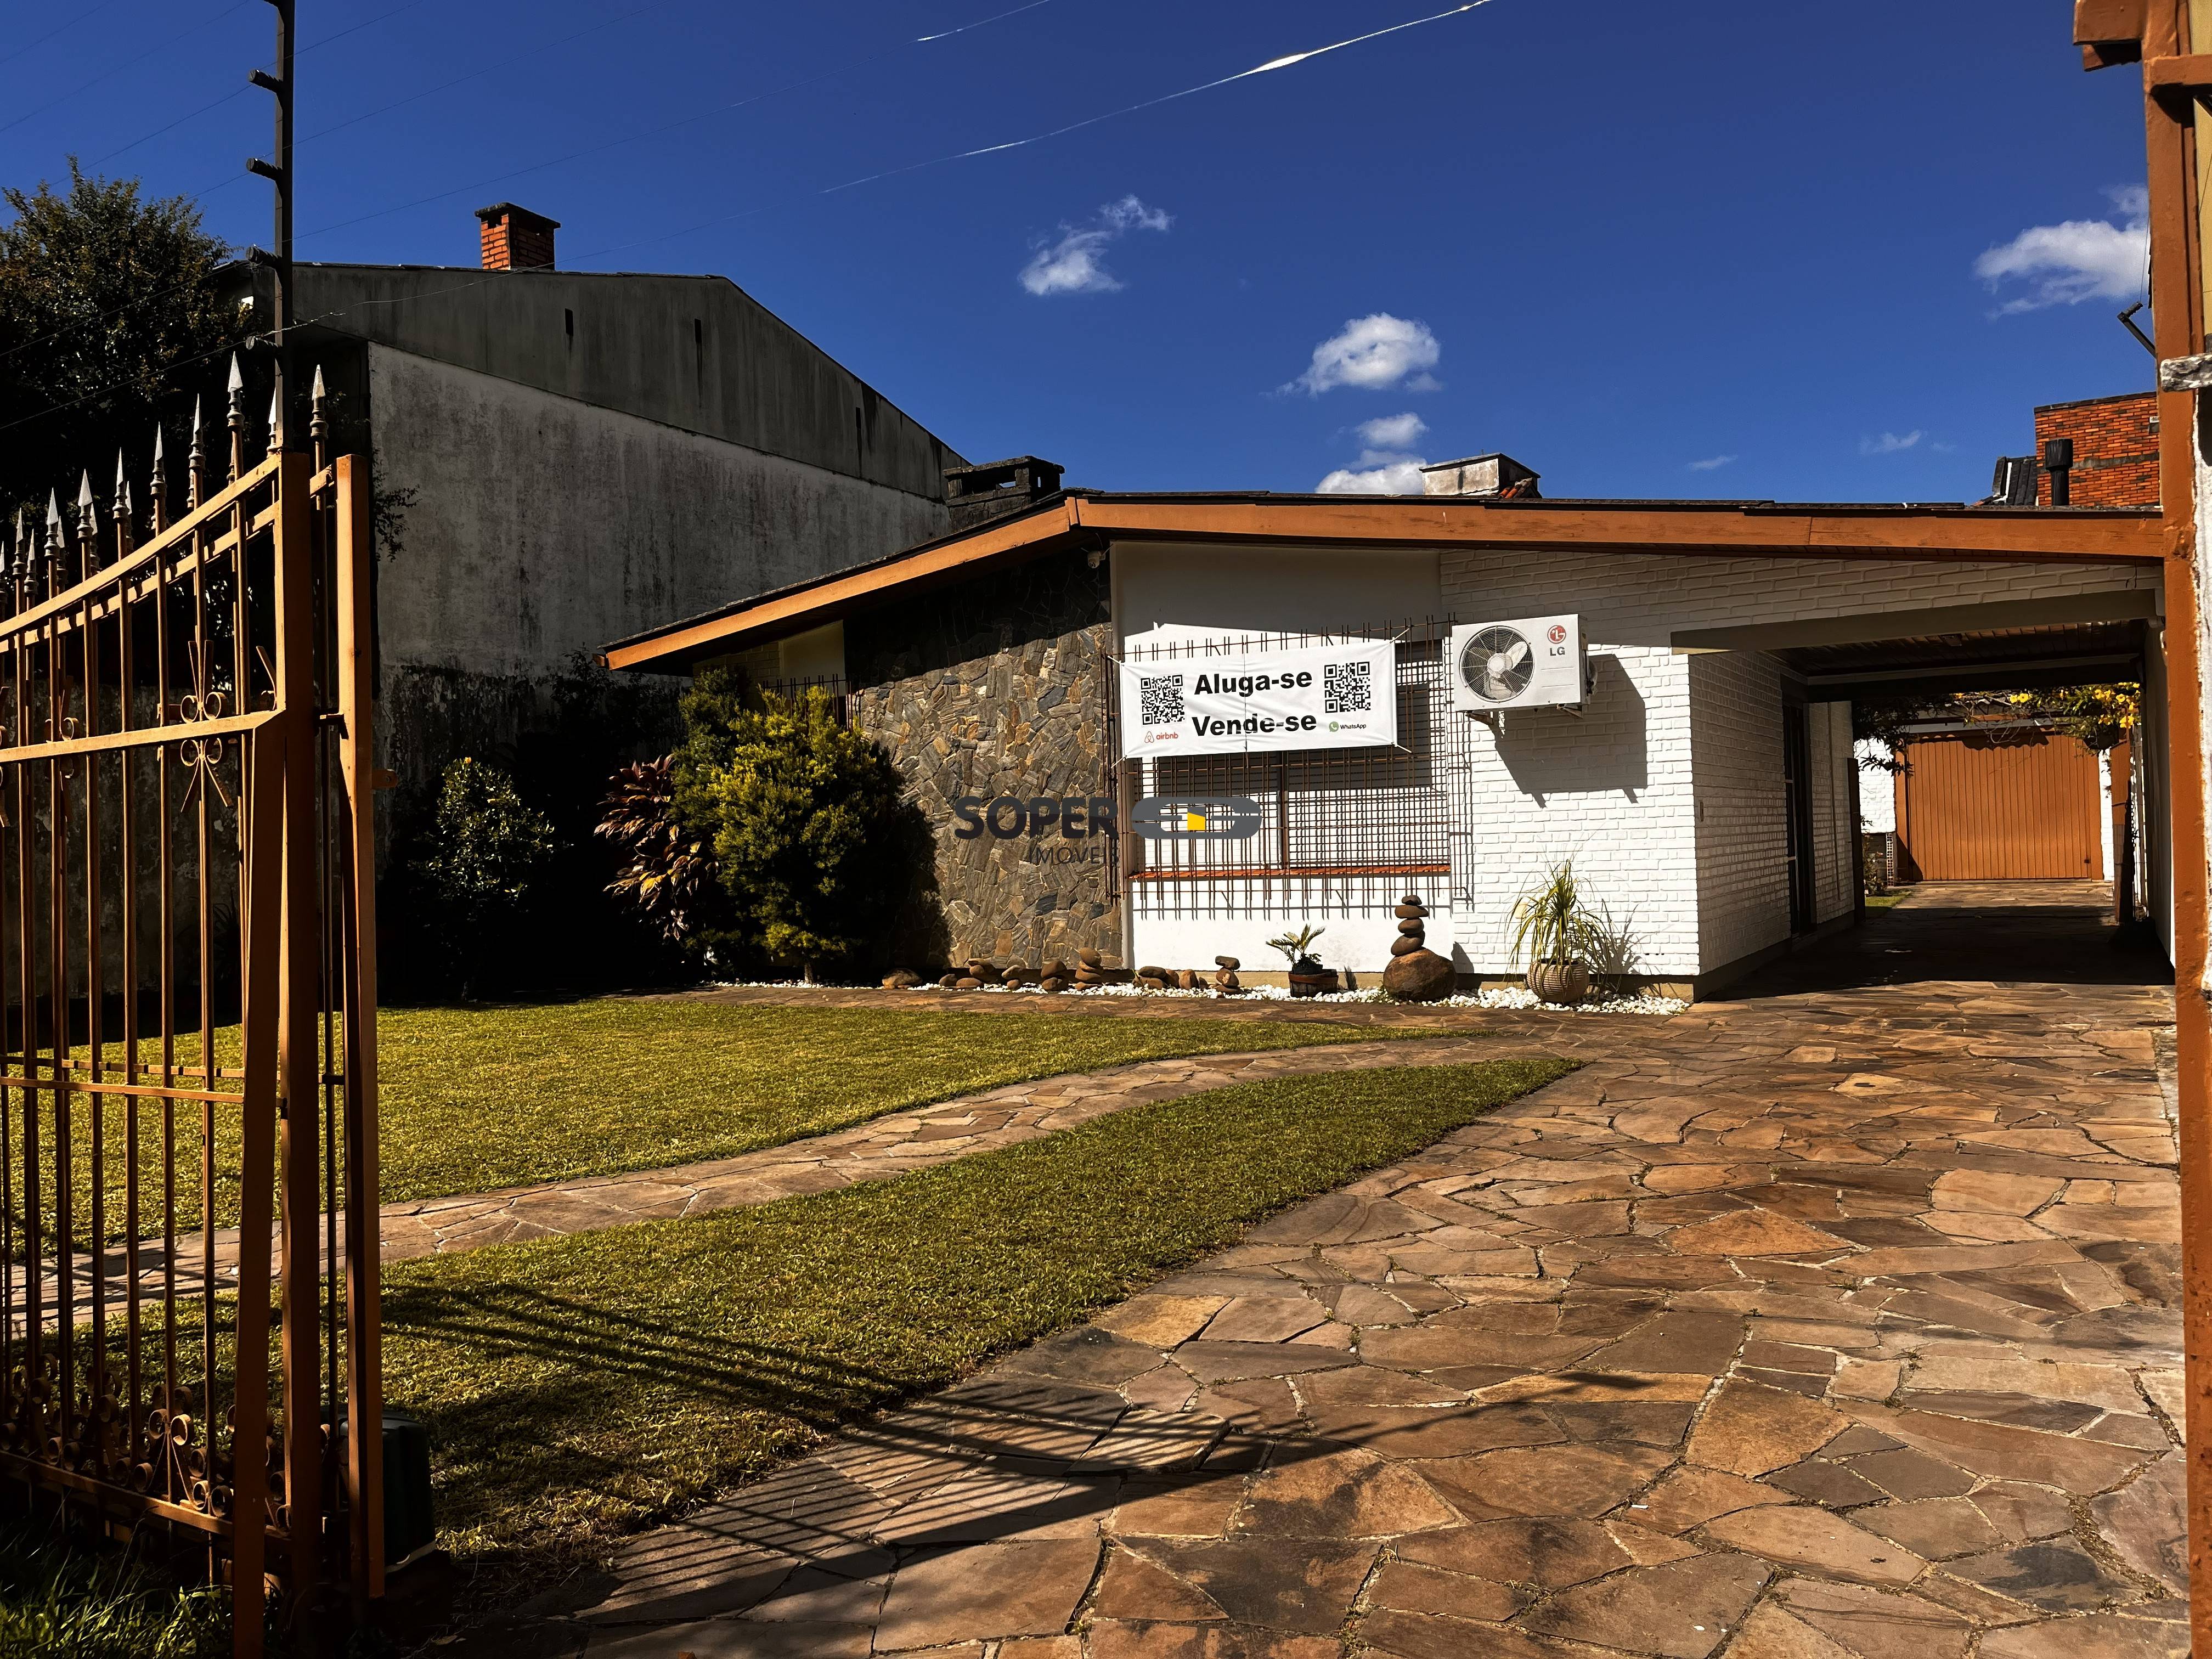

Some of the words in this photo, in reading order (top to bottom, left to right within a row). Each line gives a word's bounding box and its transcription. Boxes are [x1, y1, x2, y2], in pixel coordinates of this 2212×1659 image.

[1550, 647, 1565, 656] LG
[1194, 672, 1312, 697] Aluga-se
[1192, 713, 1317, 736] Vende-se
[1156, 731, 1178, 740] airbnb
